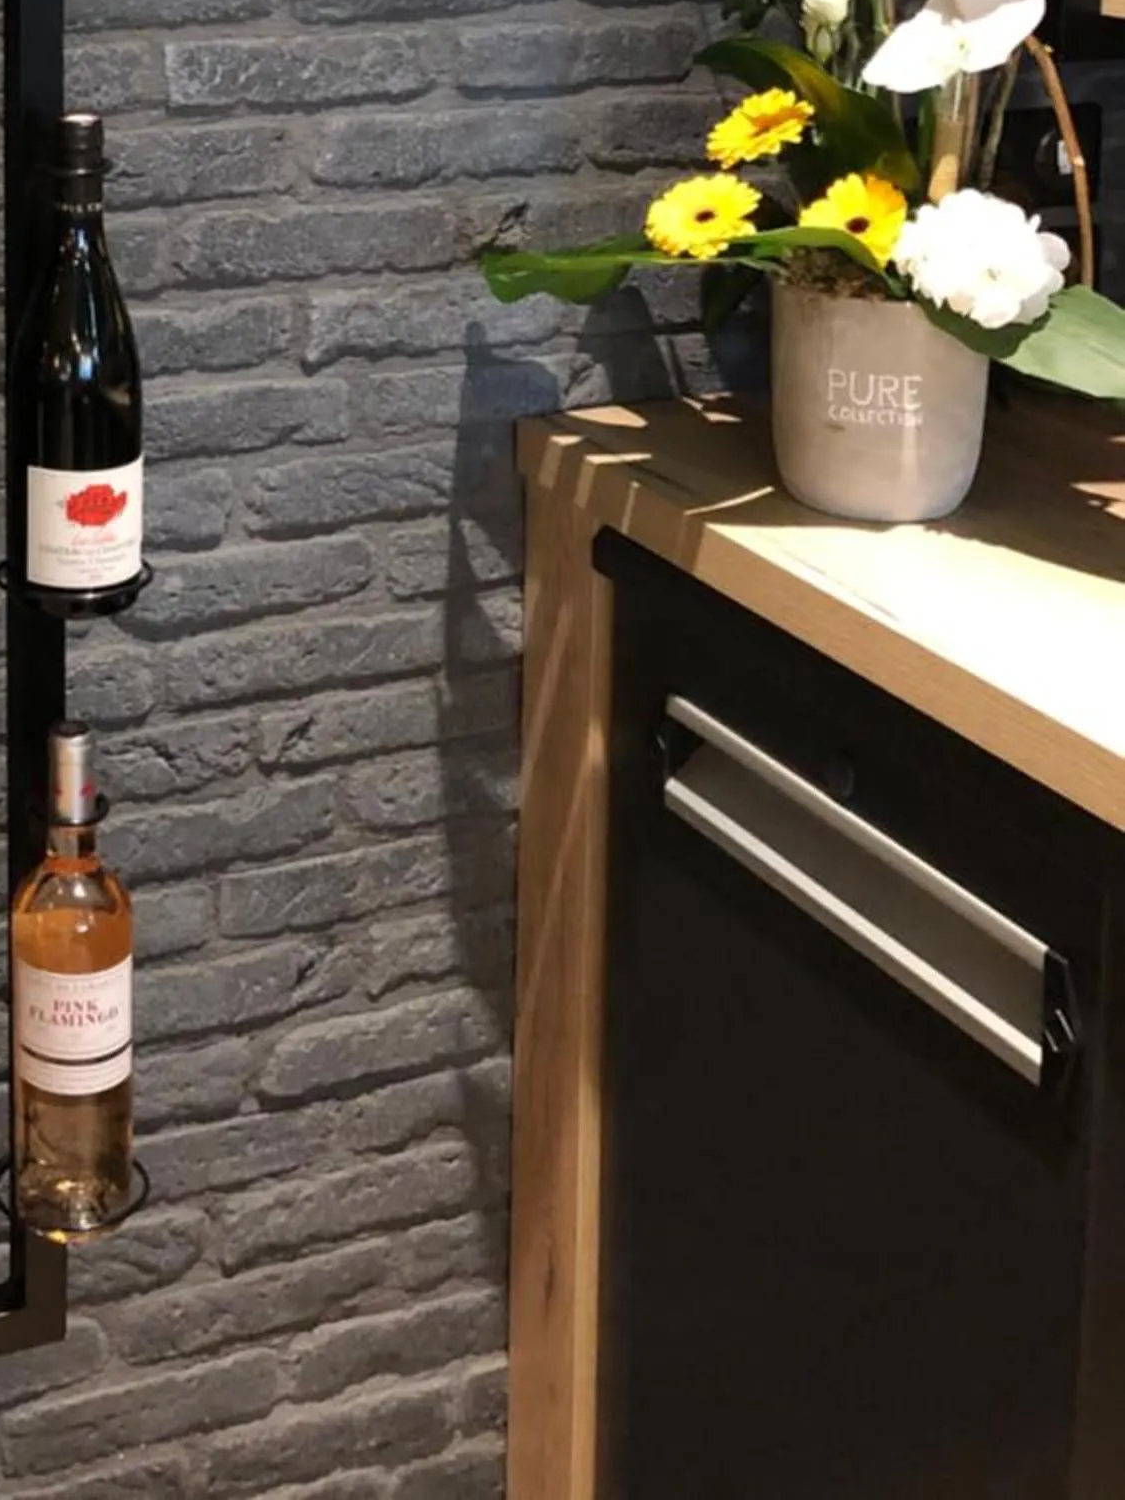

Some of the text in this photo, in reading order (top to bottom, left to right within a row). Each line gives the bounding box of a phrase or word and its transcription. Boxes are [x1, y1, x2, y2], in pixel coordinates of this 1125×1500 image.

[826, 367, 924, 411] PURE
[29, 1003, 119, 1027] FLAMINGO
[53, 1000, 99, 1012] PINK
